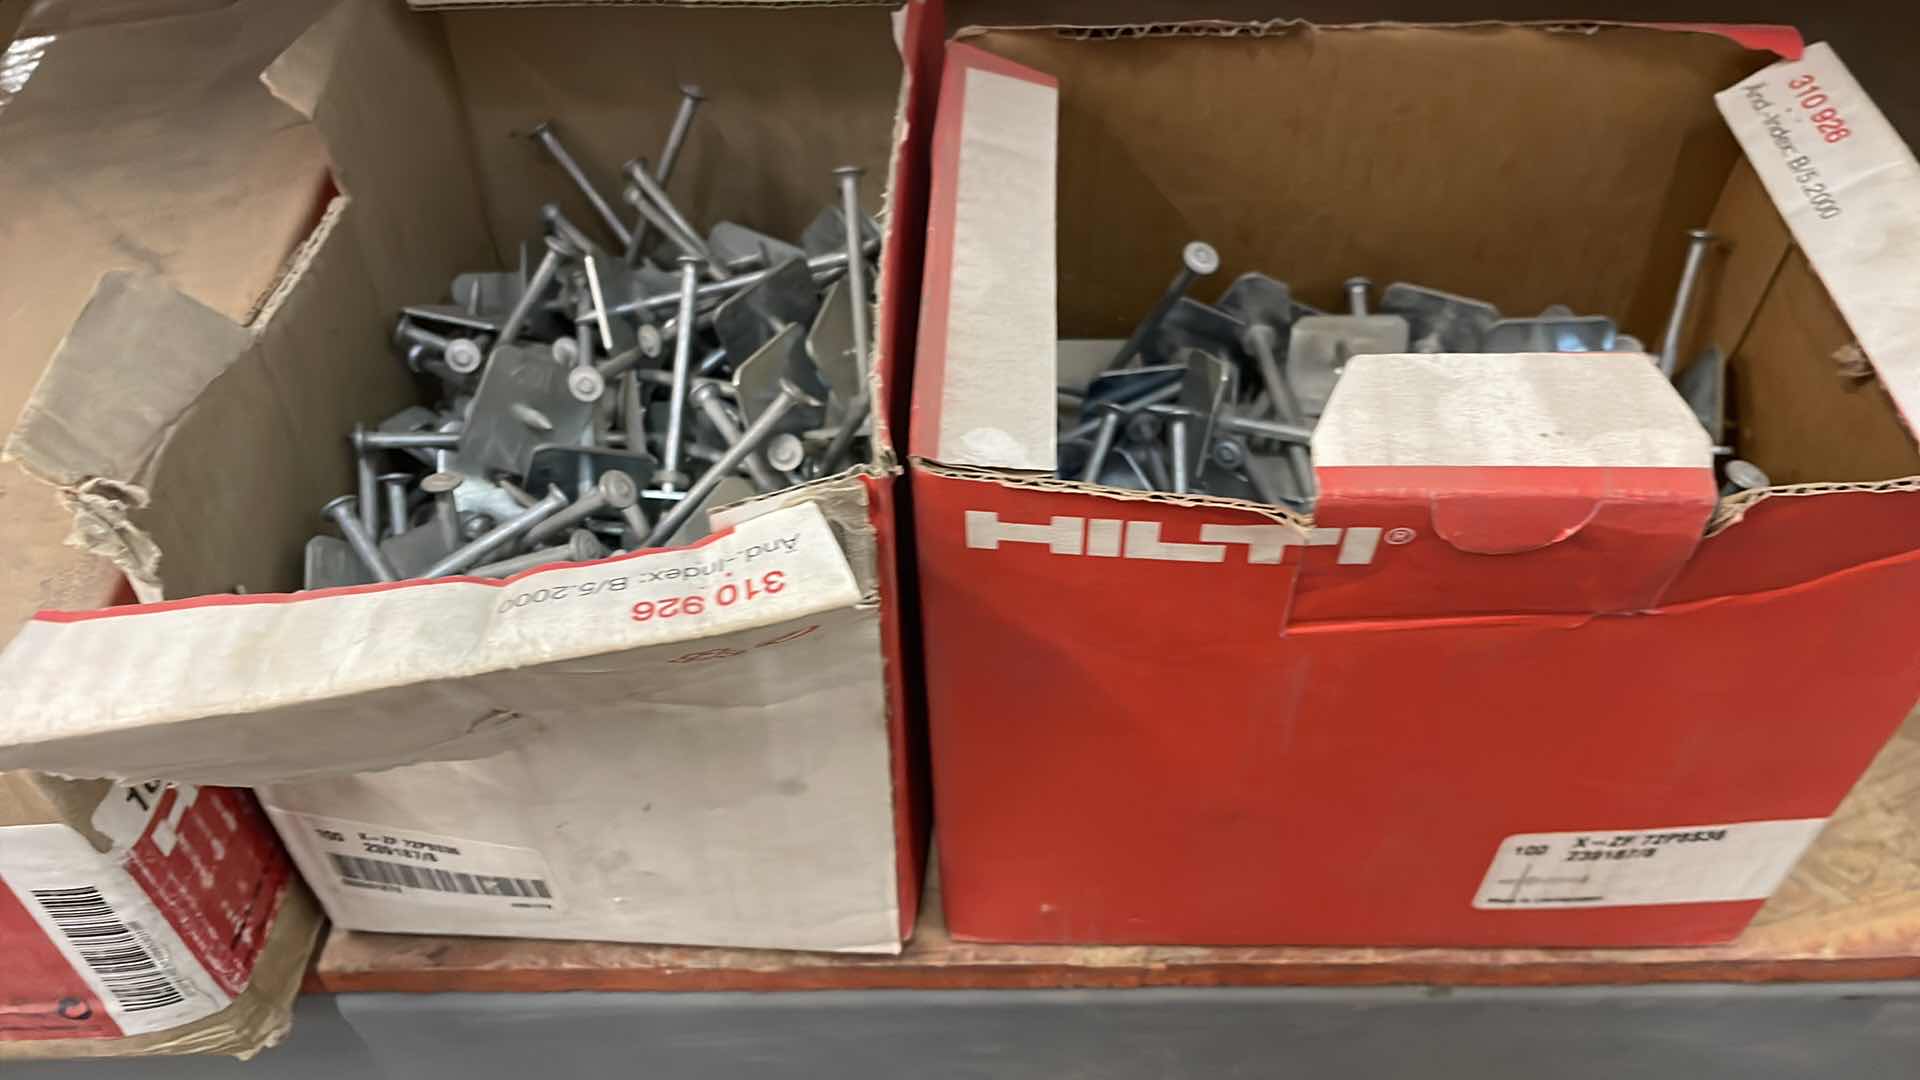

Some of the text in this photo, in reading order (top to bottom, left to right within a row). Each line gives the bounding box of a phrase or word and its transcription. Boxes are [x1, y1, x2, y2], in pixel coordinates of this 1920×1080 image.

[1788, 74, 1829, 109] 310
[964, 510, 1383, 565] HILTI
[630, 569, 786, 622] 310 926
[1515, 844, 1549, 856] 100
